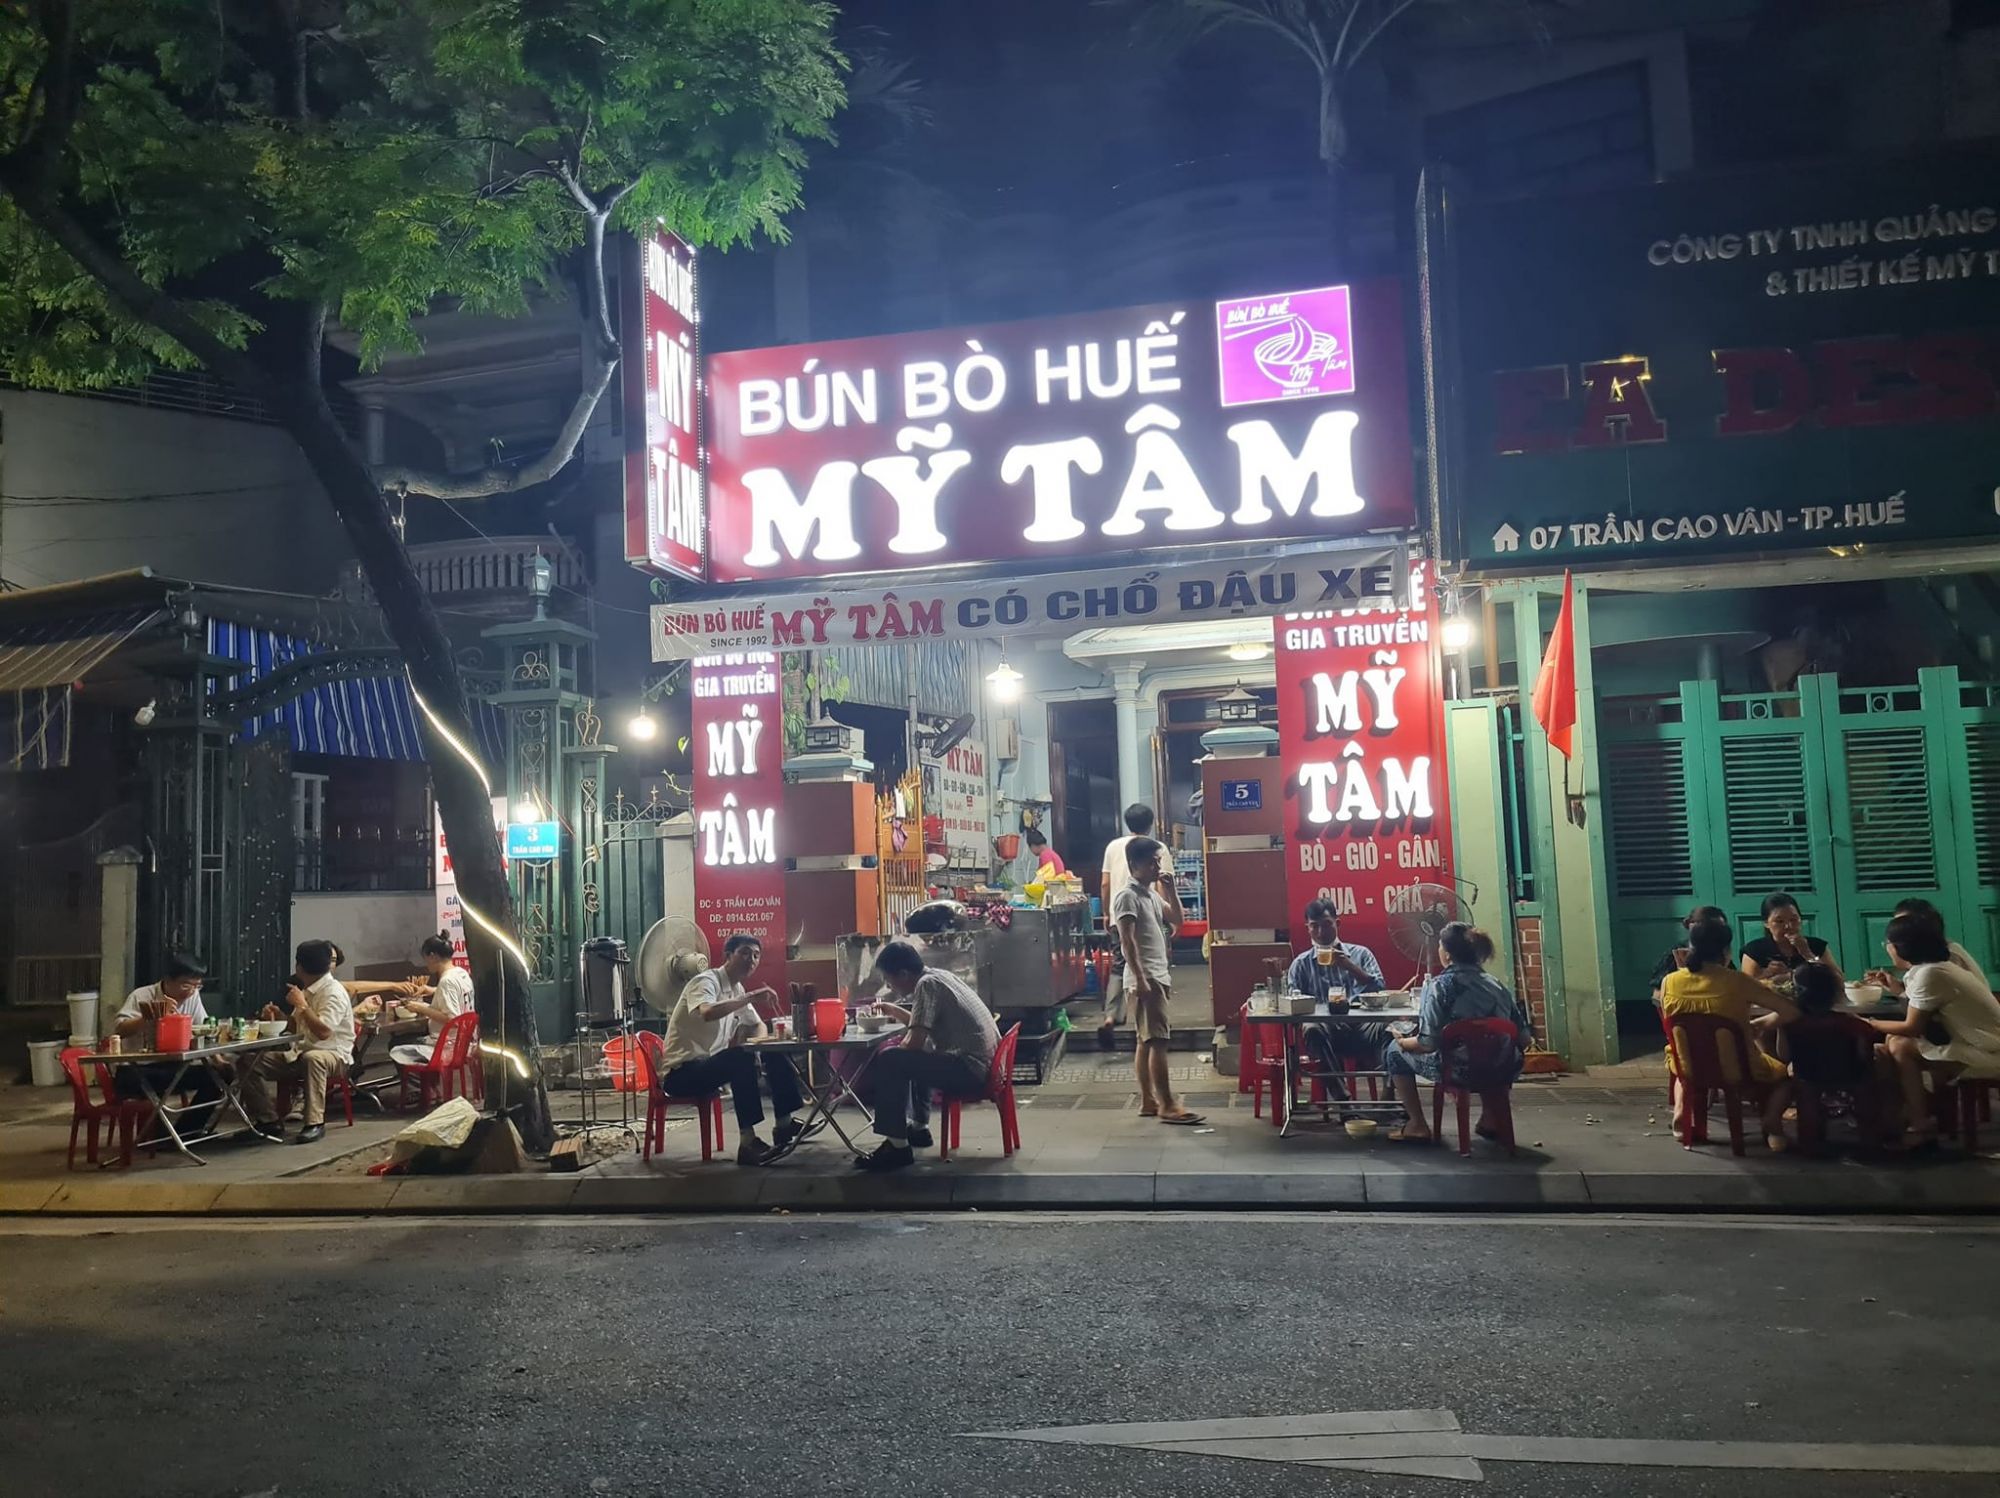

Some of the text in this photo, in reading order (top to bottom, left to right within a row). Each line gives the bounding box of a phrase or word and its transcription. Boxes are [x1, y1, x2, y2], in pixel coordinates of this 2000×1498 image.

[1648, 204, 1996, 266] CÔNG TY TNHH QUẢNG
[1766, 271, 1787, 296] &
[1794, 254, 1872, 293] THIẾT
[1877, 248, 1921, 285] KẾ
[657, 331, 692, 434] MỸ
[739, 312, 1186, 436] BÚN BÒ HUẾ
[652, 437, 701, 554] TÂM
[740, 403, 1366, 567] MỸ TÂM
[1529, 525, 1562, 550] 07
[1570, 513, 1645, 548] TRẦN
[1652, 517, 1718, 542] CAO
[1723, 508, 1783, 536] VÂN
[664, 602, 766, 636] BÚN BÒ HUẾ
[771, 597, 837, 647] MỸ
[848, 592, 946, 641] TÂM
[957, 588, 1028, 629] CÓ
[1178, 571, 1297, 614] ĐẬU
[1317, 565, 1393, 602] XE
[710, 636, 767, 647] SINCE 1992
[1286, 615, 1428, 650] GIA TRUYỀN
[694, 665, 775, 697] GIA TRUYỀN
[1312, 650, 1406, 733] MỸ
[707, 704, 763, 777] MỸ
[1235, 784, 1249, 799] 5
[1299, 740, 1434, 824] TÂM
[528, 827, 538, 842] 3
[699, 792, 776, 866] TÂM
[1300, 838, 1326, 872] BÒ
[1346, 836, 1379, 871] GIÒ
[1398, 834, 1440, 868] GÂN
[717, 899, 721, 908] 5
[748, 897, 764, 907] CAO
[1384, 876, 1424, 913] CHẢ
